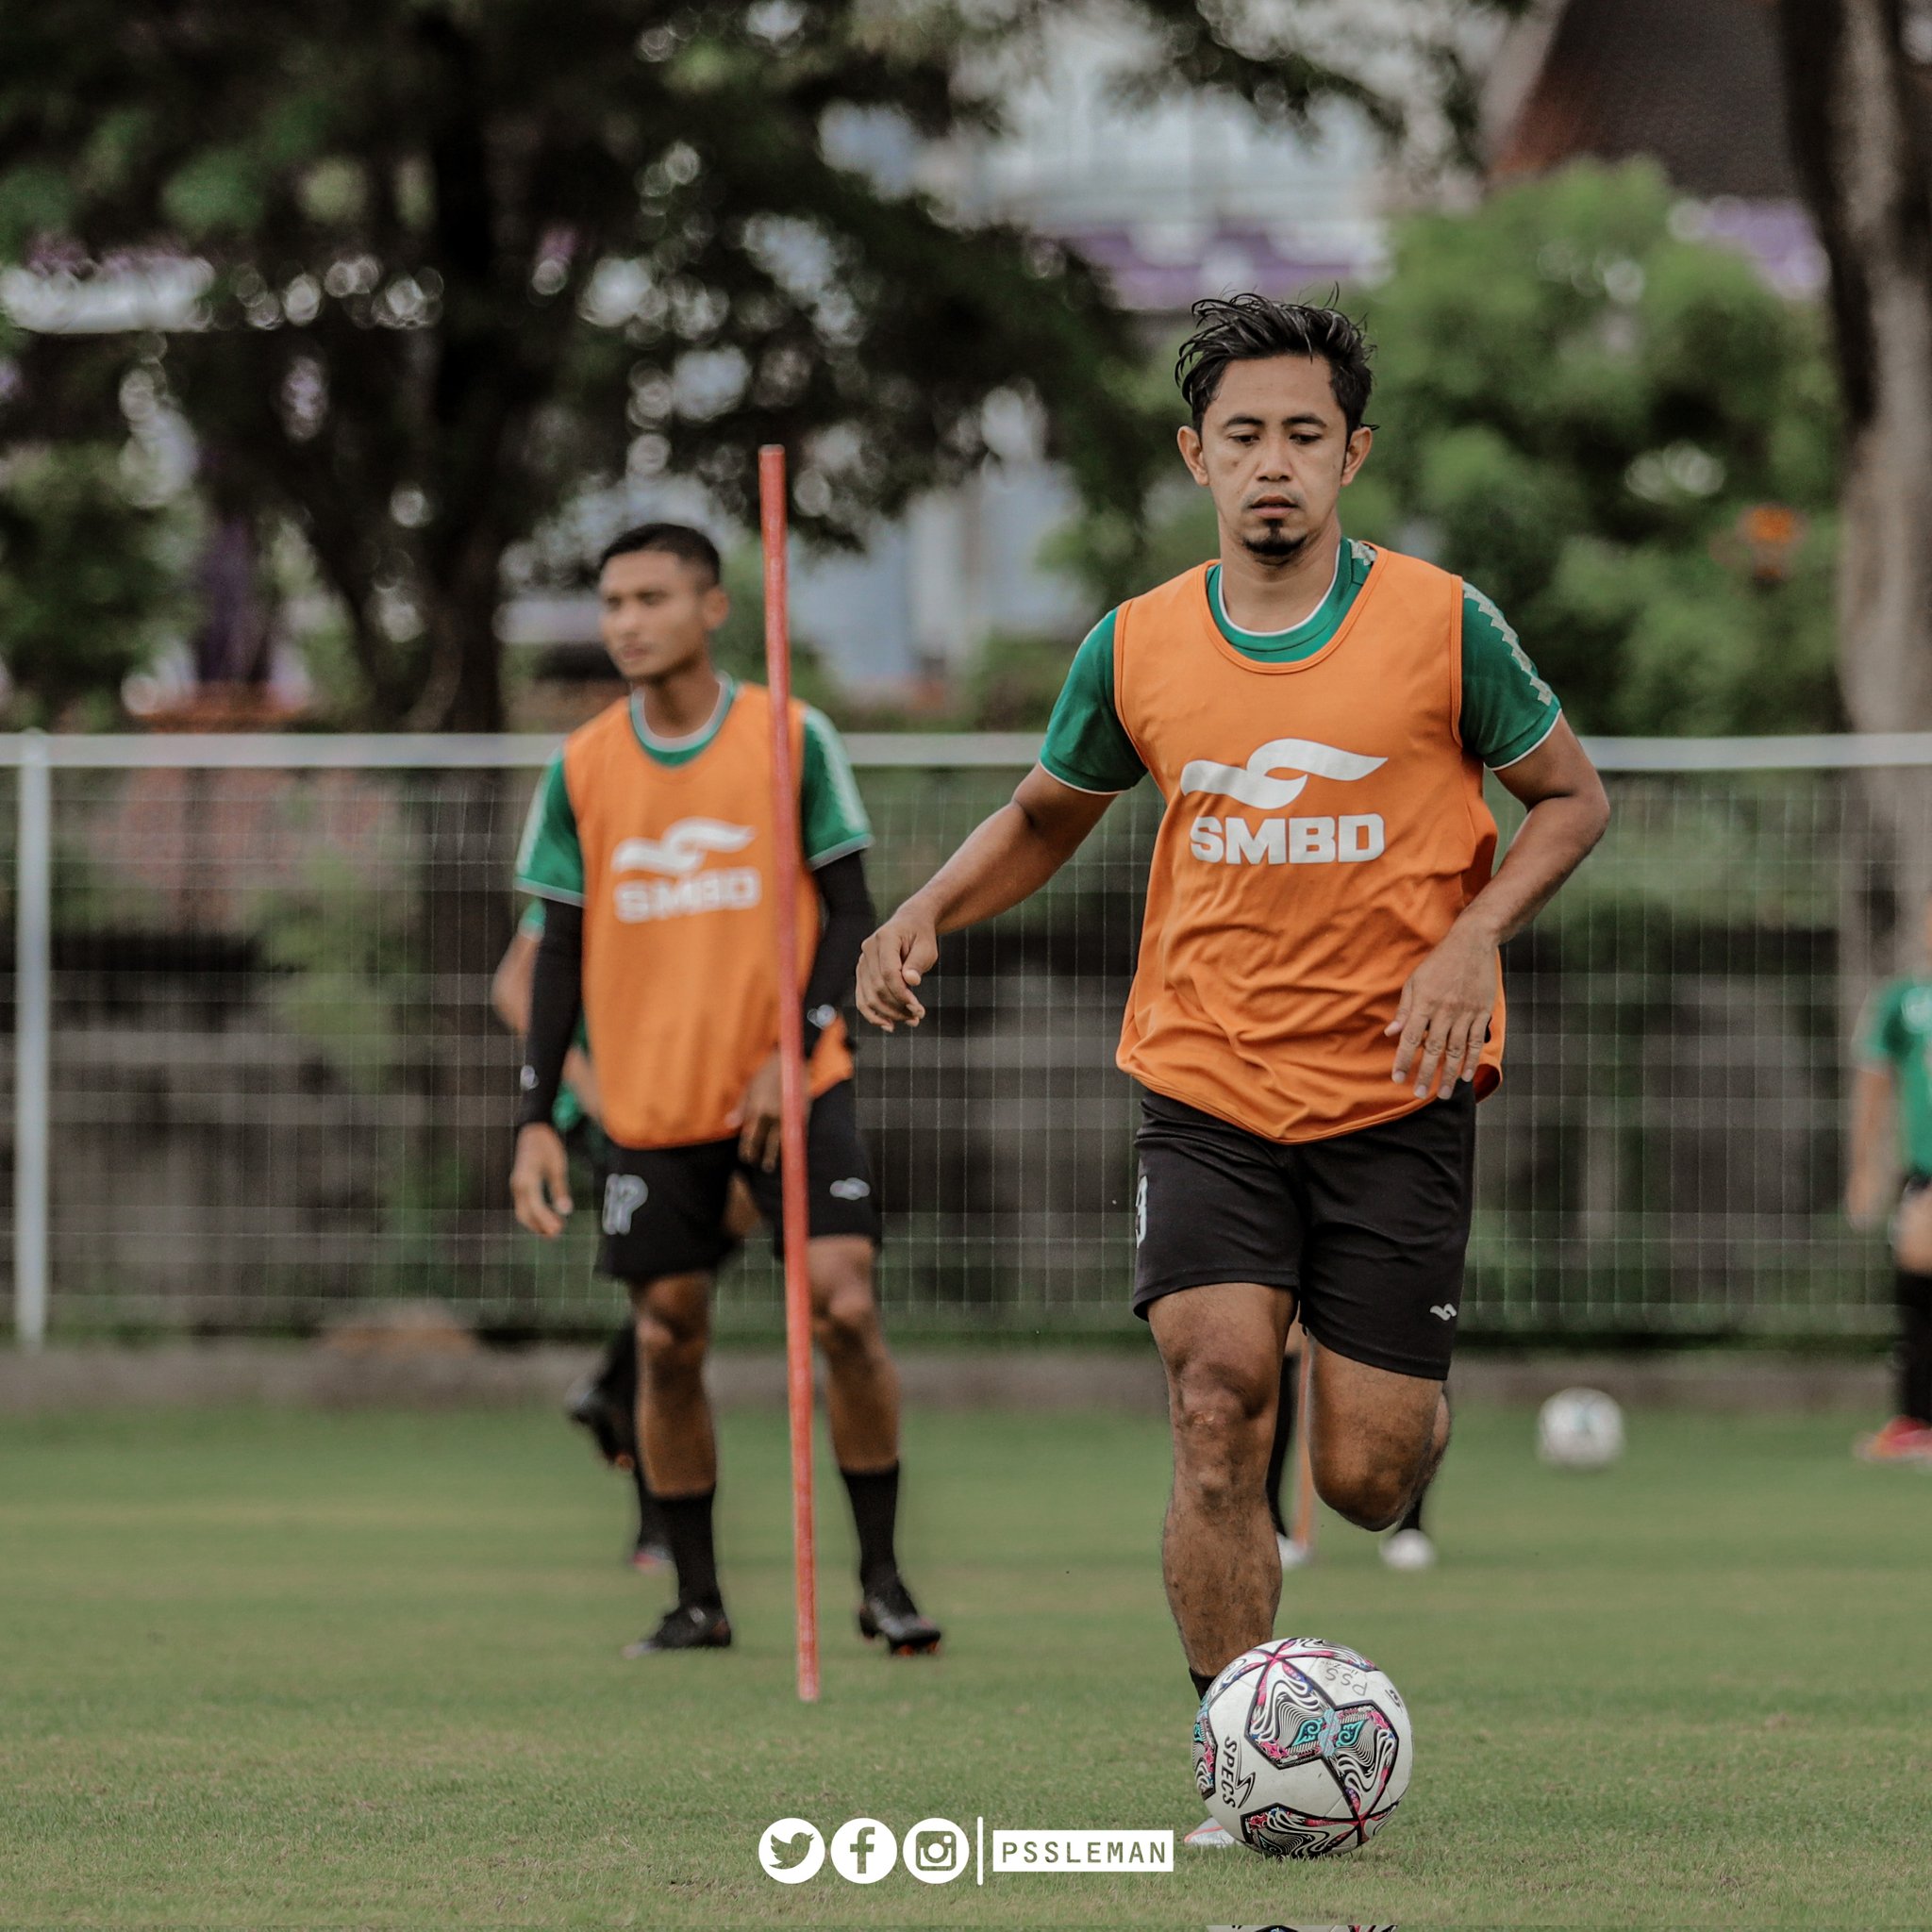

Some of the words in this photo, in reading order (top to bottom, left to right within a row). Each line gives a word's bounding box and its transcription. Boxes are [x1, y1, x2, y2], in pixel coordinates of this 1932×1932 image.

[1190, 813, 1385, 865] SMBD
[613, 867, 760, 923] SMBD
[1325, 1668, 1368, 1697] PSS
[1222, 1734, 1238, 1808] SPECS
